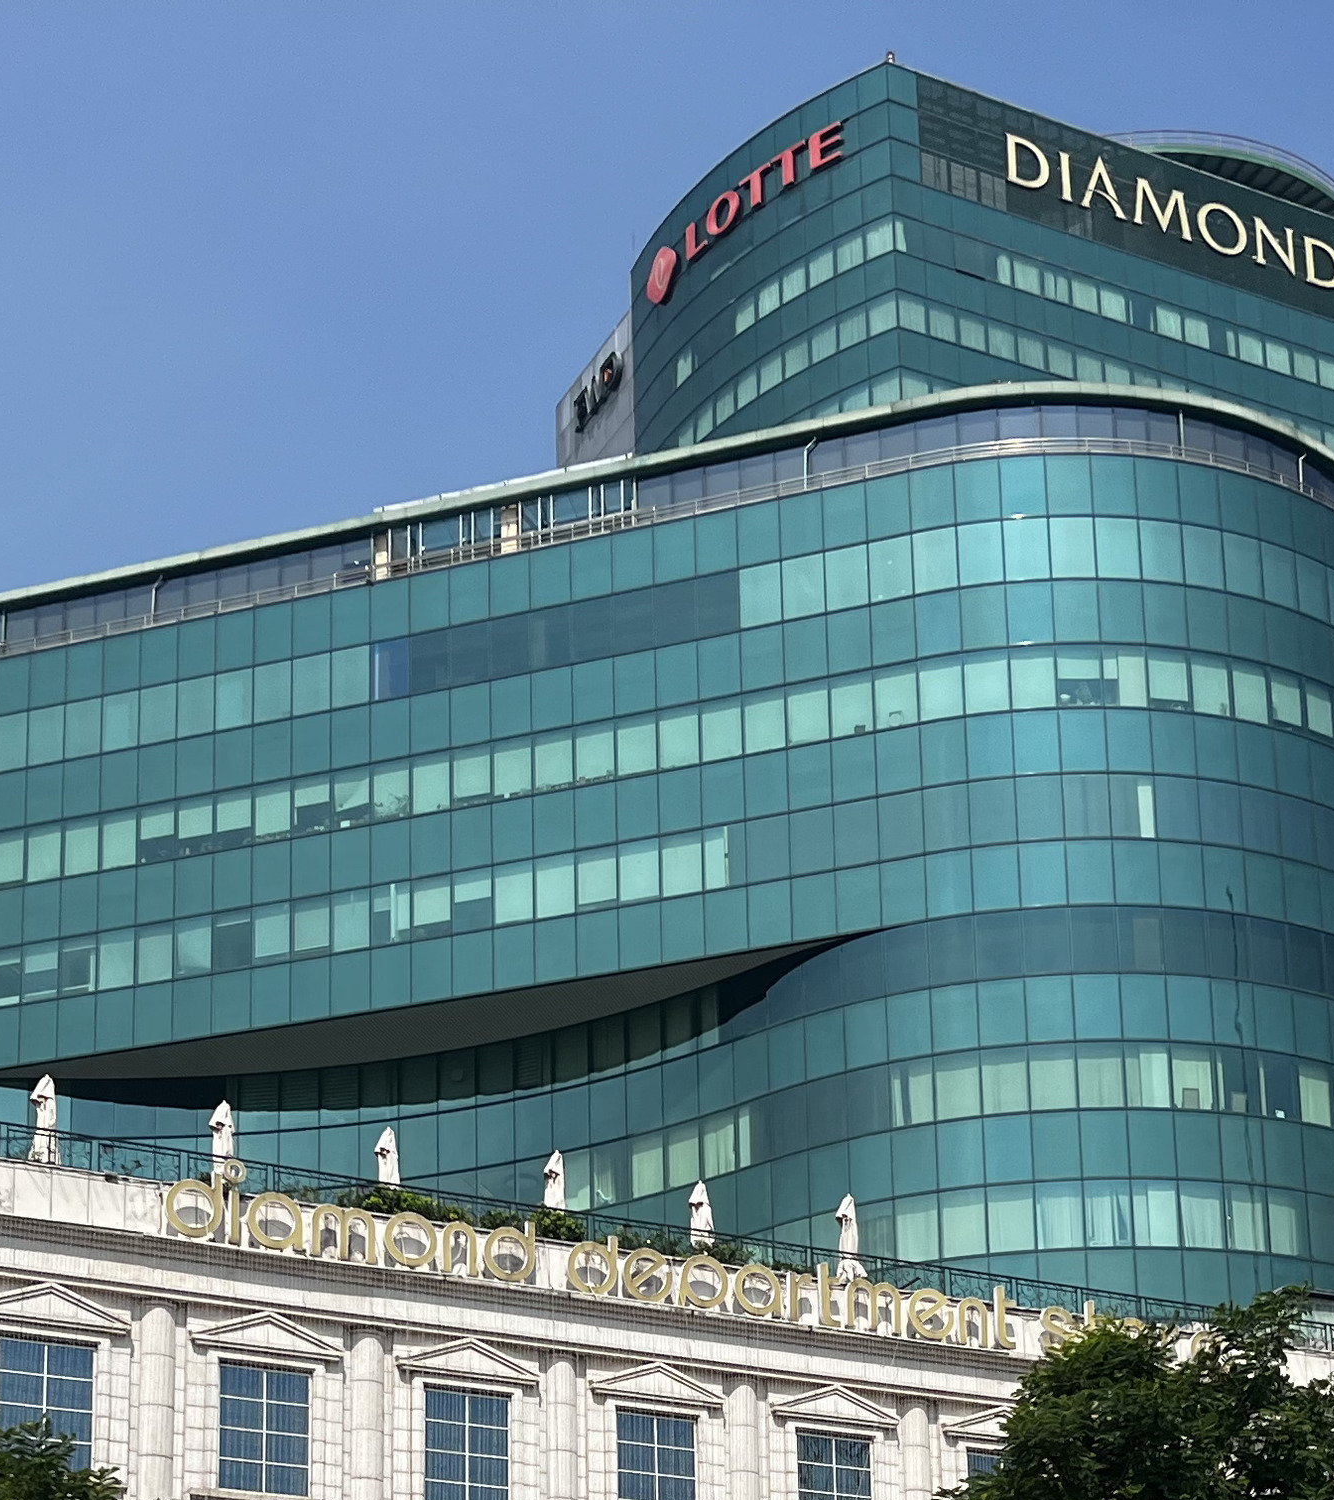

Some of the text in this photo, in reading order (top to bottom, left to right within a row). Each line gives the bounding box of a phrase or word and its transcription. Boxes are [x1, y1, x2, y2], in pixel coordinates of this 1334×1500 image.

[685, 121, 843, 261] LOTTE
[166, 1158, 536, 1282] diamond
[567, 1235, 1017, 1350] department
